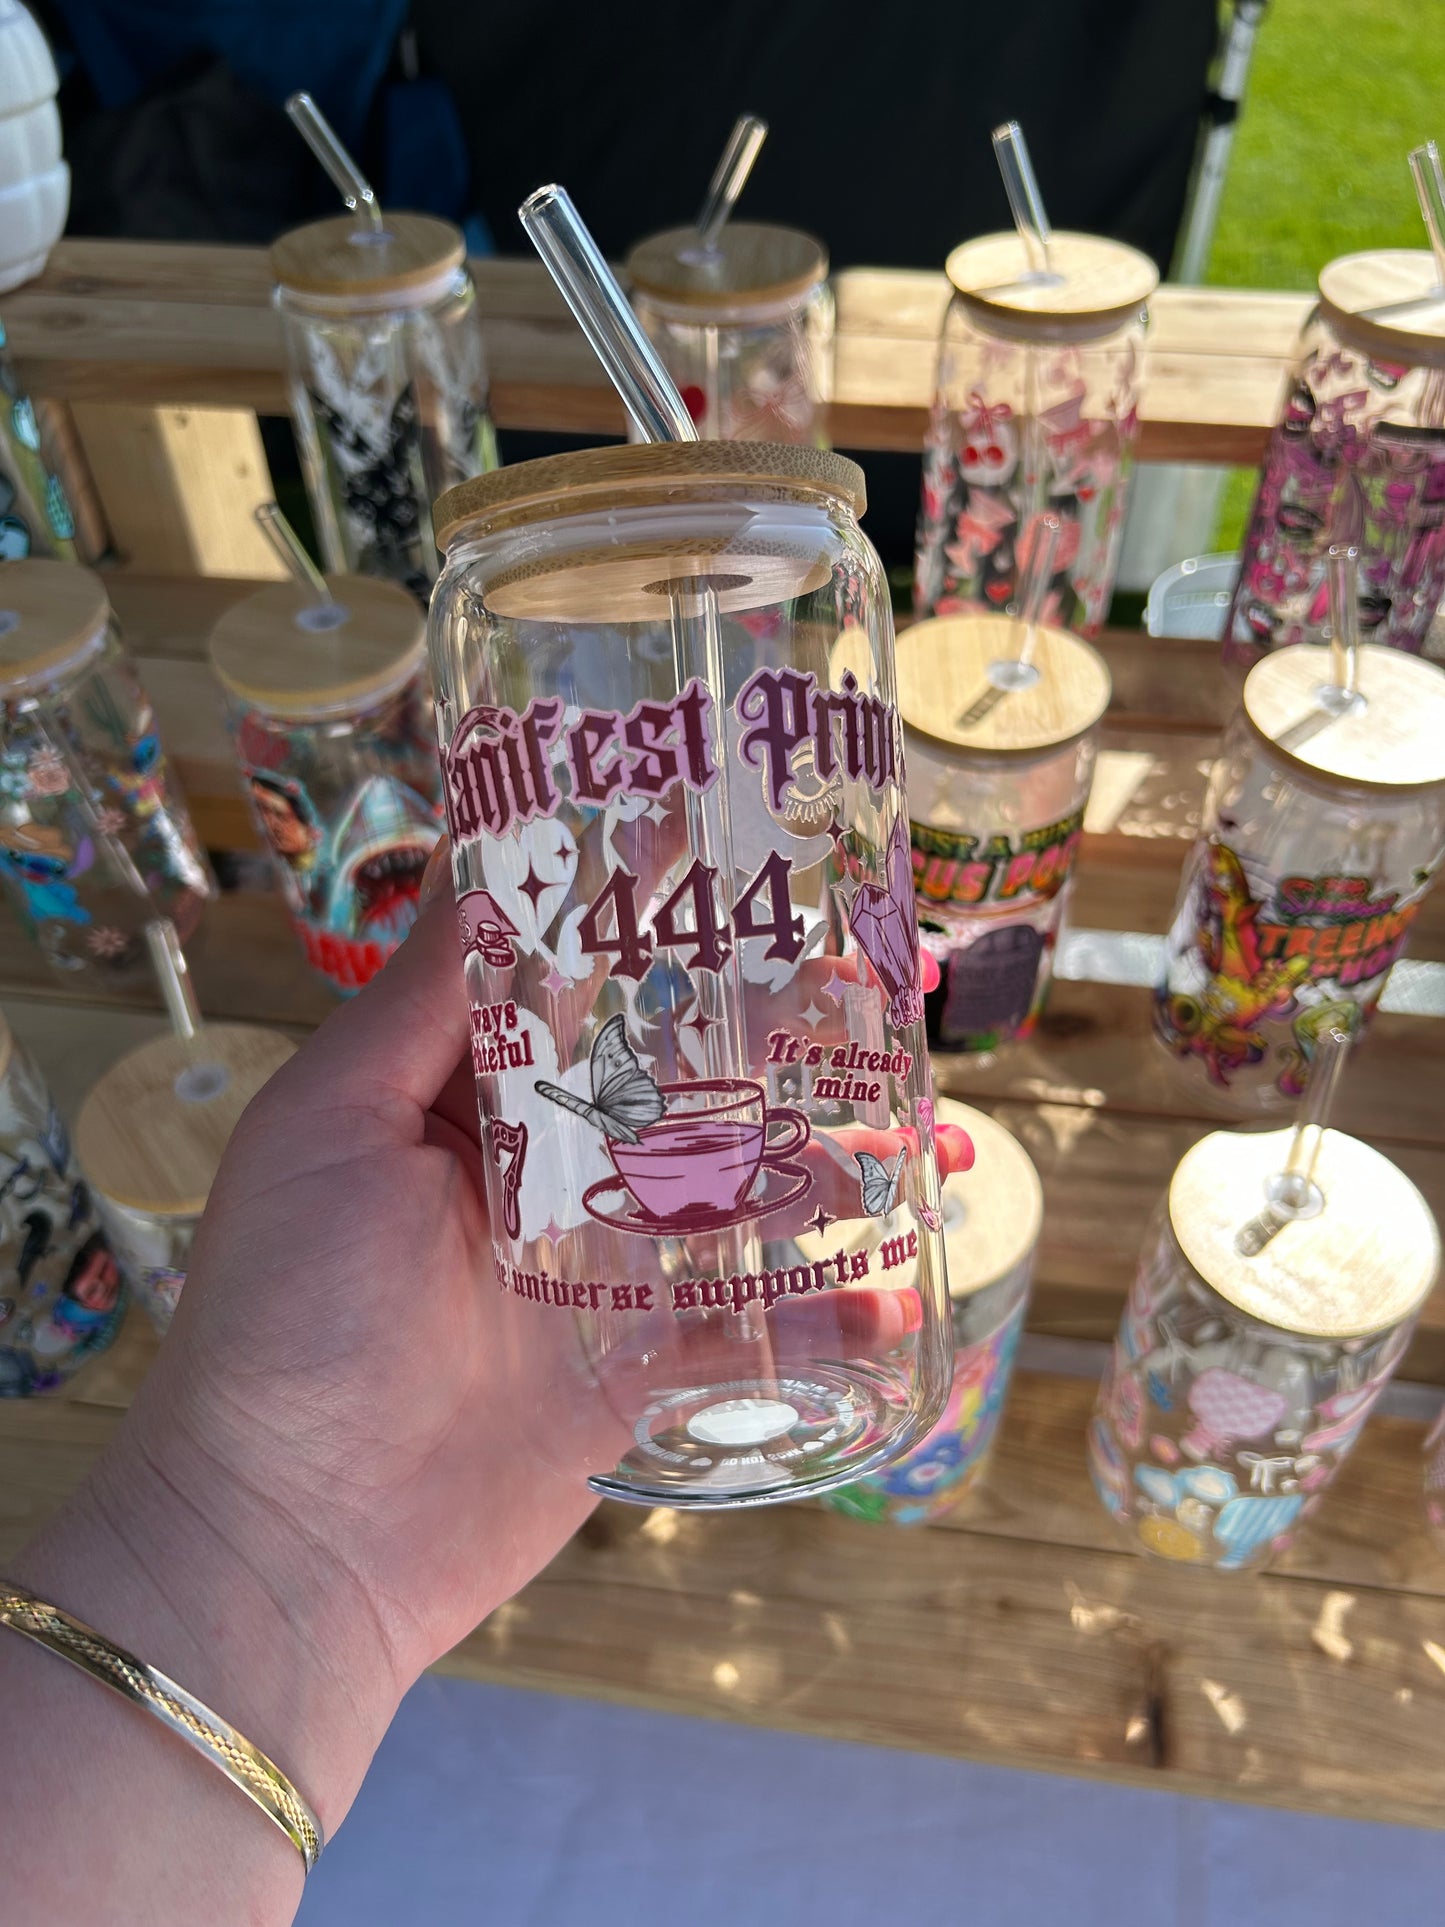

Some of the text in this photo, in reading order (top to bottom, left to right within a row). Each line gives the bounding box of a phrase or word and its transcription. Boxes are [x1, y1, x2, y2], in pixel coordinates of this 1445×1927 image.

[446, 680, 719, 843] anifest
[577, 850, 806, 982] 444
[469, 1001, 518, 1041] ways
[767, 1031, 913, 1081] It's already
[812, 1073, 881, 1103] mine
[511, 1228, 918, 1315] universe supports me
